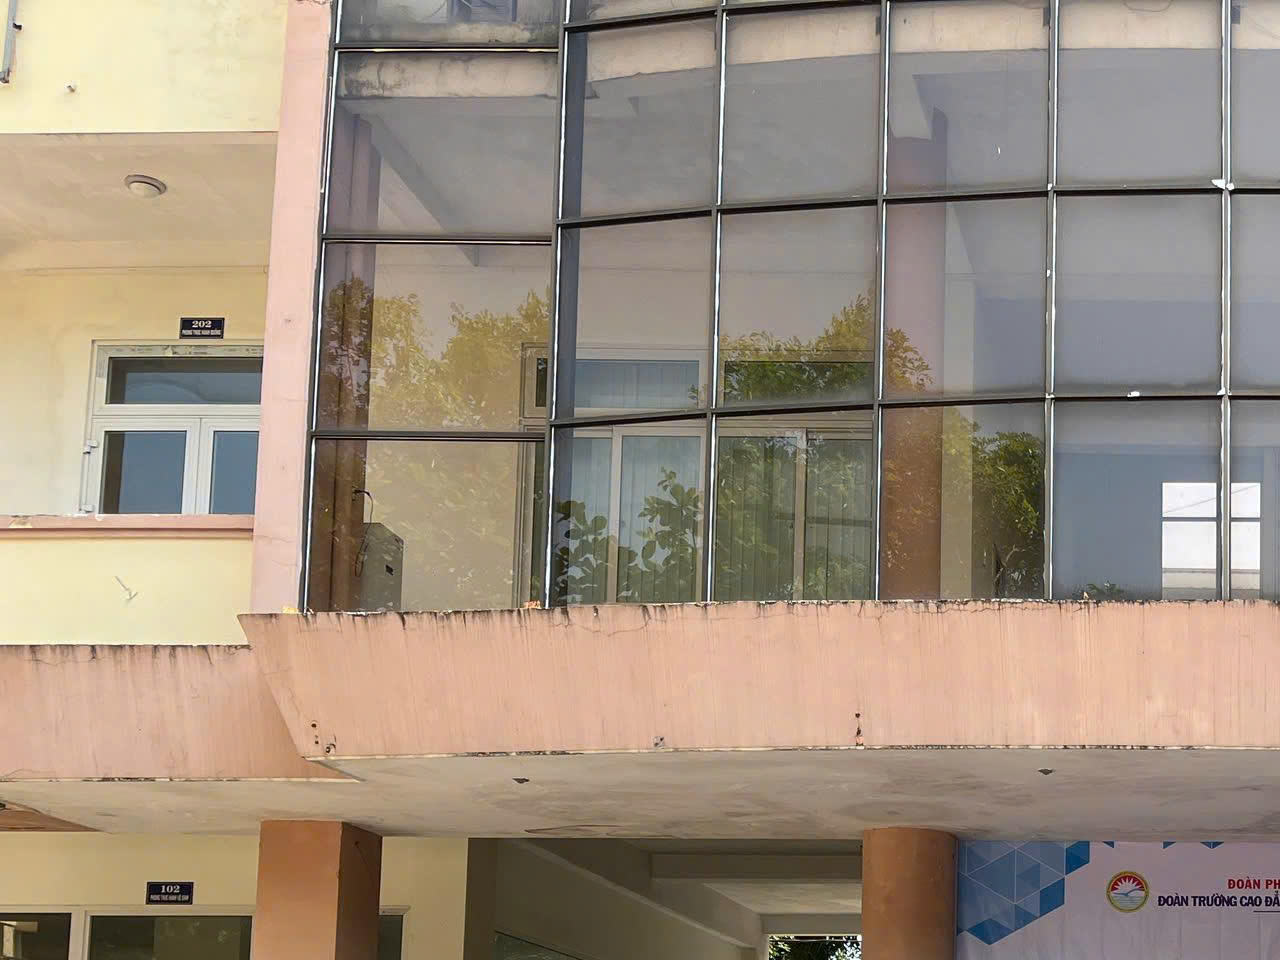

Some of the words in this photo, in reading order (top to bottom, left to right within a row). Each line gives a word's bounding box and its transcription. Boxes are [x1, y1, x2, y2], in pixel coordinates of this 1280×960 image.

[192, 320, 212, 328] 202
[1228, 876, 1261, 889] ĐOÀN
[161, 885, 180, 893] 102
[1158, 893, 1188, 906] ĐOÀN
[1191, 893, 1237, 906] TRƯỜNG
[1240, 896, 1262, 906] CAO
